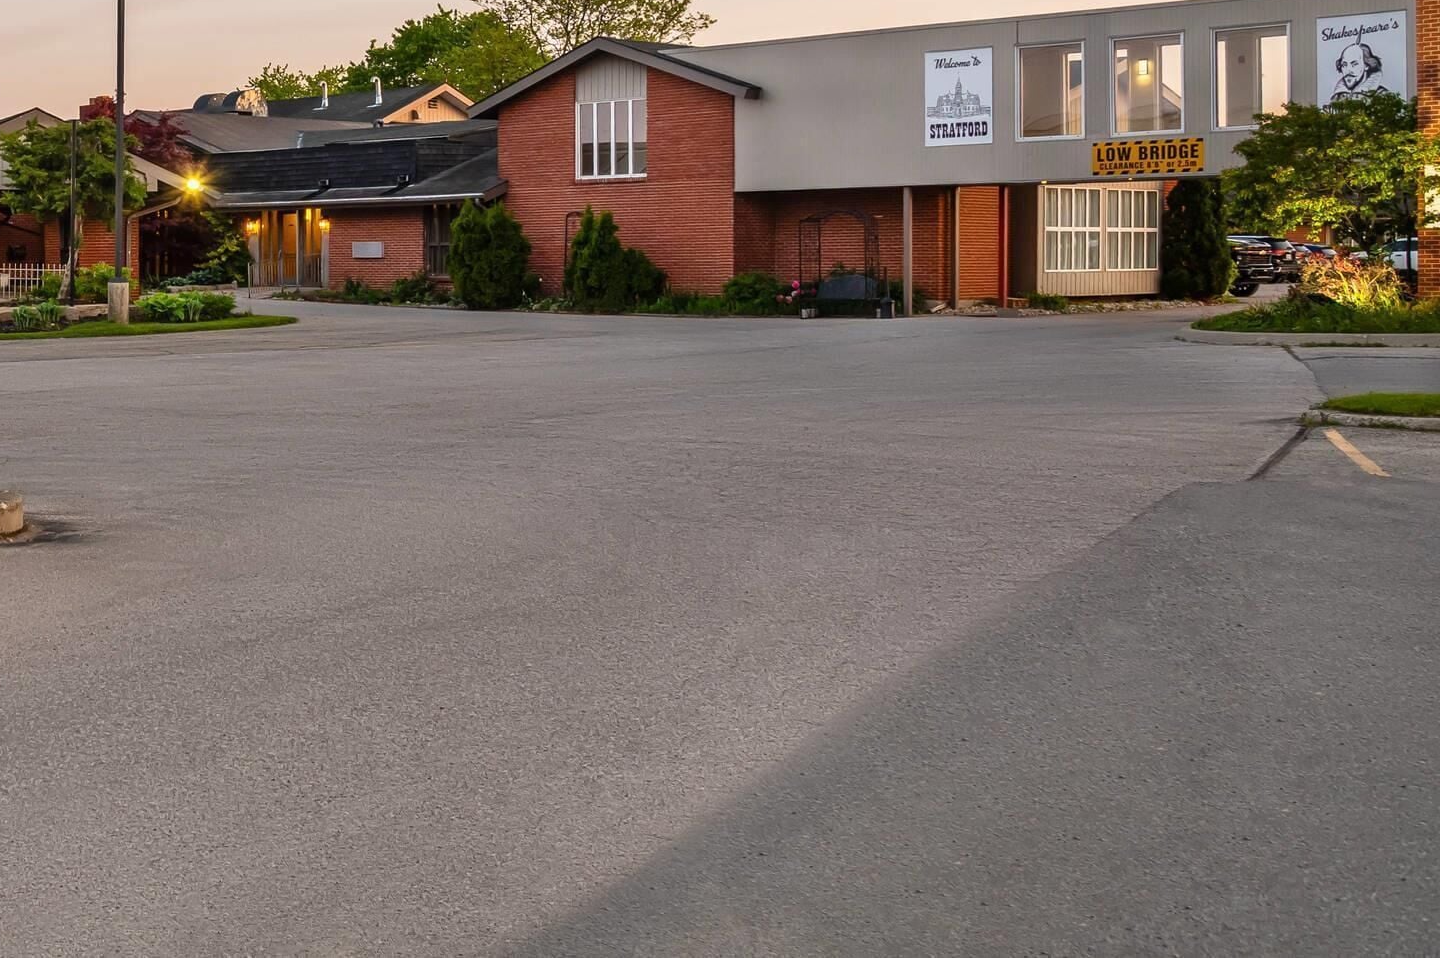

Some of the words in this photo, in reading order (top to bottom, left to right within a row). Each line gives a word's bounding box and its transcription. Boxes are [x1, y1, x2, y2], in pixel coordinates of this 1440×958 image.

[1321, 18, 1400, 45] Shakespeare's
[934, 57, 971, 70] Welcome
[970, 55, 983, 67] to
[929, 121, 989, 139] STRATFORD
[1097, 146, 1132, 162] LOW
[1138, 144, 1200, 160] BRIDGE
[1099, 161, 1145, 171] CLEARANCE
[1166, 160, 1175, 168] or
